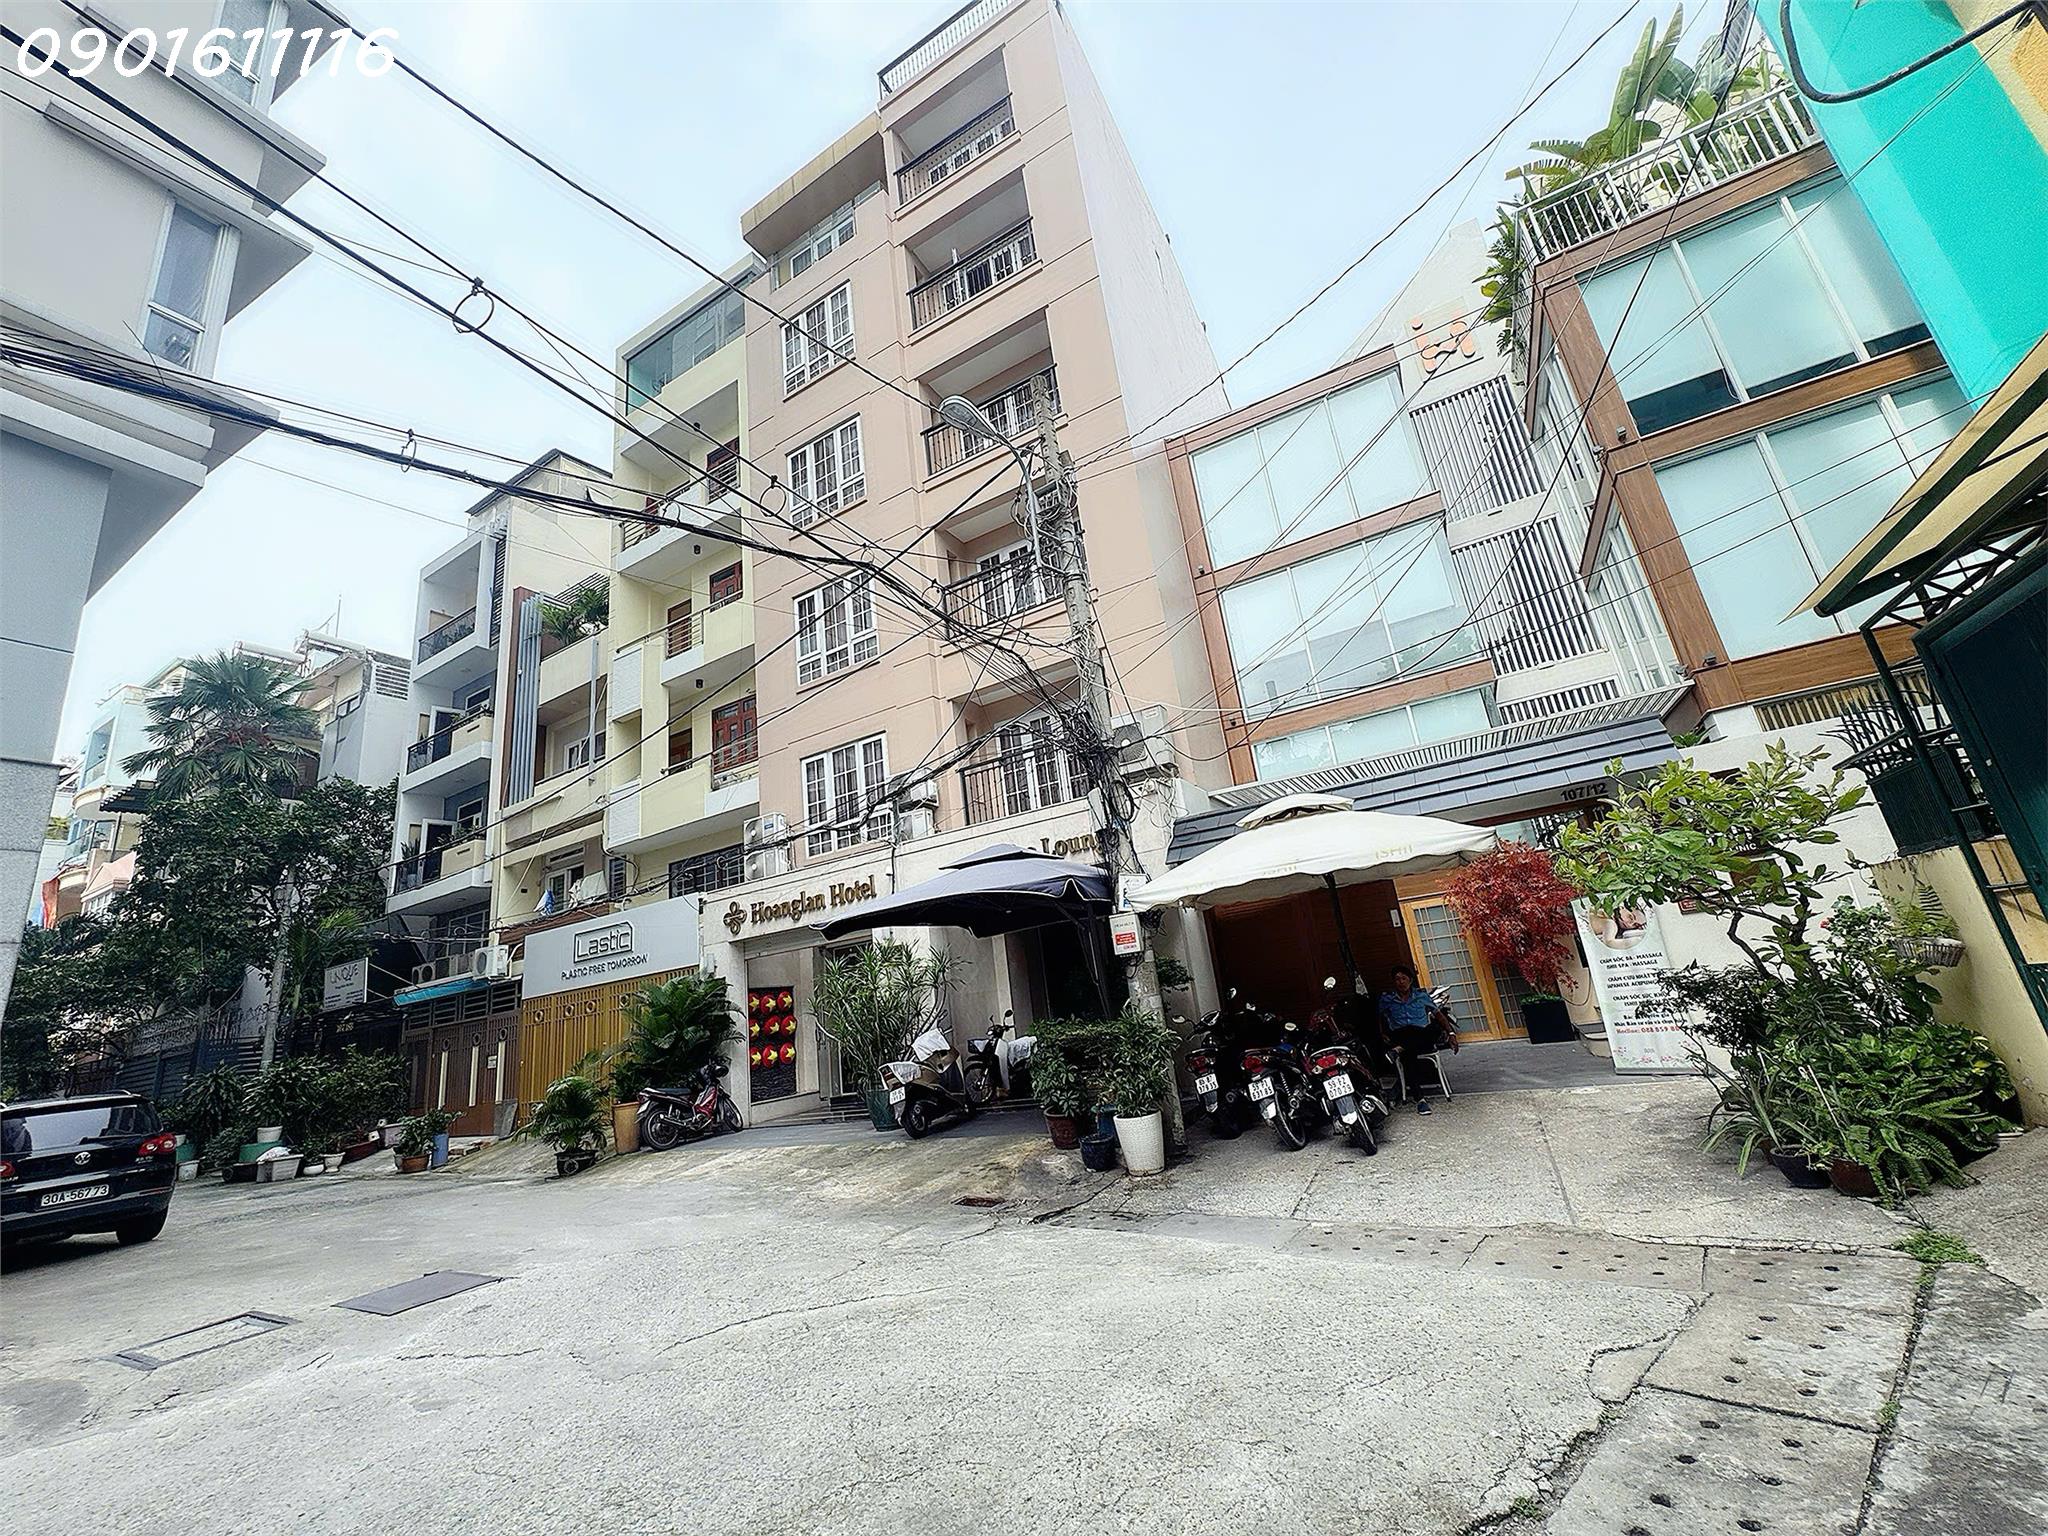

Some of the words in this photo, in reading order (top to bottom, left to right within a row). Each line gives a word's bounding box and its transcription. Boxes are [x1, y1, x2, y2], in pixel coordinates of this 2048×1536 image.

[1561, 783, 1608, 801] 107/12
[750, 890, 826, 924] Hoanglan
[829, 874, 877, 907] Hotel
[577, 929, 630, 958] Lastic
[561, 967, 588, 980] PLASTIC
[588, 962, 607, 976] FREE
[607, 953, 648, 971] TOMORROW
